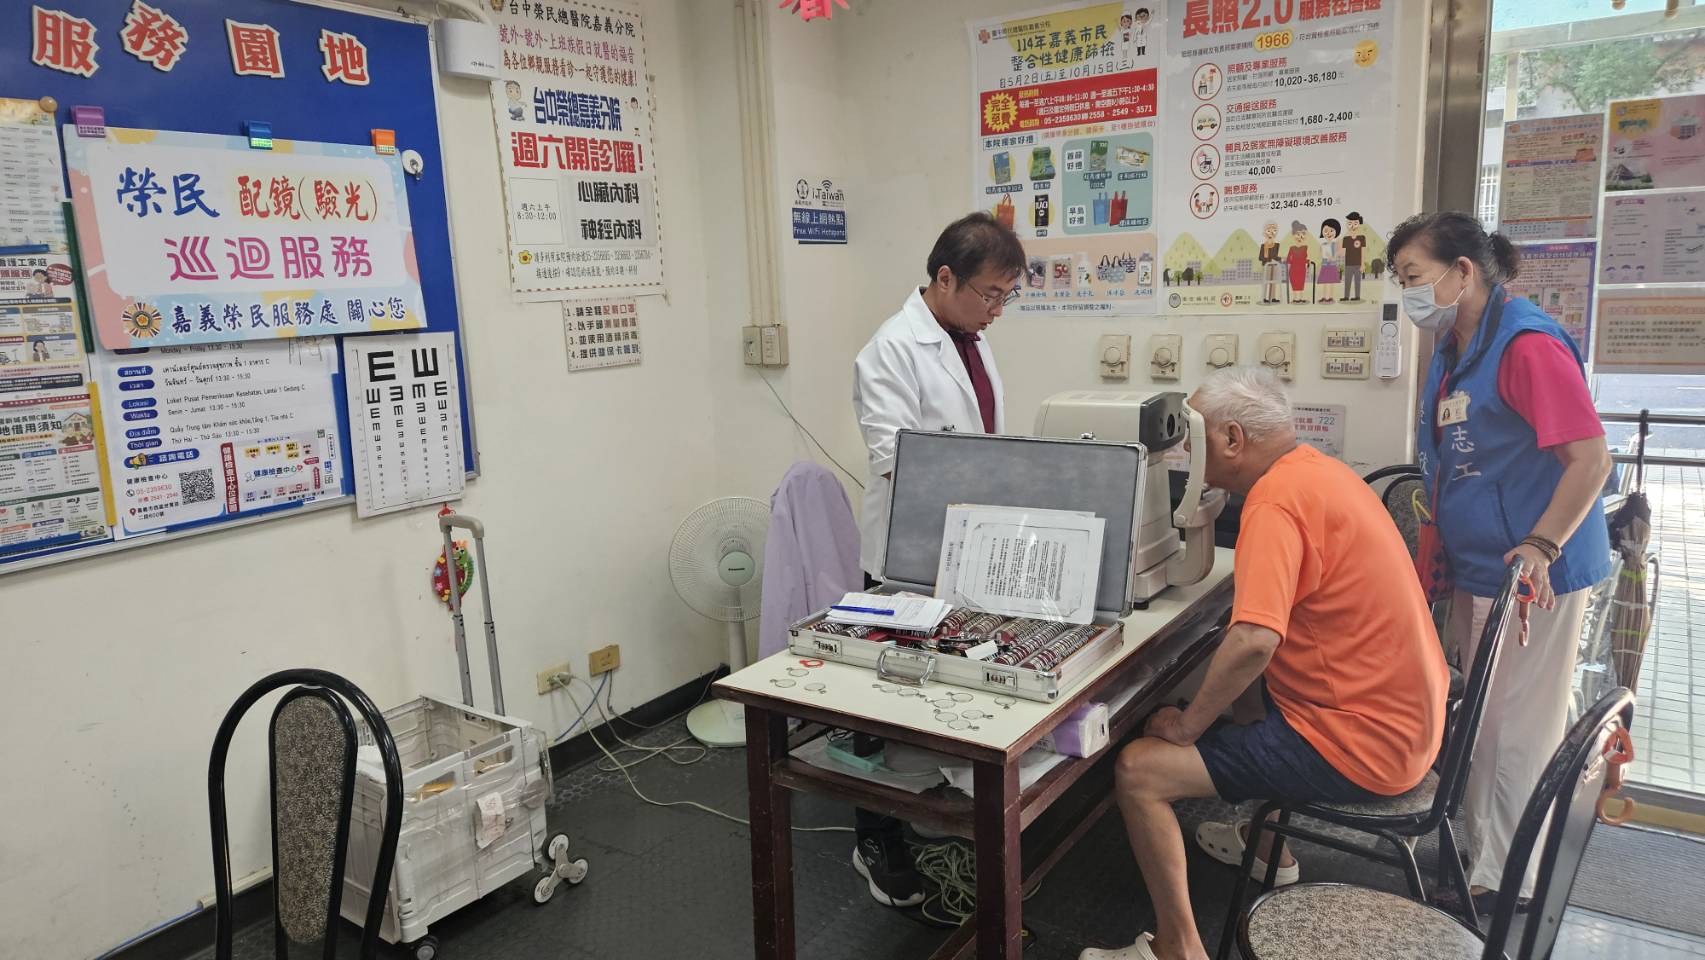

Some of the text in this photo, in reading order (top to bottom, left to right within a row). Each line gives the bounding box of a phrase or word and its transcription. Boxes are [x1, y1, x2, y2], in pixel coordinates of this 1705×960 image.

[509, 0, 636, 38] 台中榮民總醫院嘉義分院
[1183, 0, 1293, 39] 長照2.0
[34, 1, 370, 84] 服務園地
[1016, 25, 1108, 52] 114年嘉義市民
[1257, 32, 1290, 49] 1966
[1011, 41, 1115, 71] 整合性健康篩檢
[1227, 57, 1288, 75] 照顧及專業服務
[533, 86, 622, 131] 台中榮總嘉義分院
[991, 98, 1011, 112] 完全
[1226, 99, 1277, 114] 交通接送服務
[511, 132, 644, 173] 週六開診囉!
[985, 136, 1034, 149] 本院獨家好禮
[1225, 131, 1347, 153] 輔具及居家無障礙環境改善服務
[1248, 165, 1276, 176] 40,000
[116, 166, 220, 218] 榮民
[238, 174, 379, 223] 配鏡(驗光)
[578, 181, 640, 204] 心臟內科
[521, 203, 551, 211] 週六上午
[793, 211, 844, 225] 無線上網熱點
[580, 219, 642, 240] 神經內科
[164, 236, 374, 282] 巡迴服務
[170, 296, 407, 334] 嘉義榮民服務處 關心您
[1452, 425, 1482, 480] 志工
